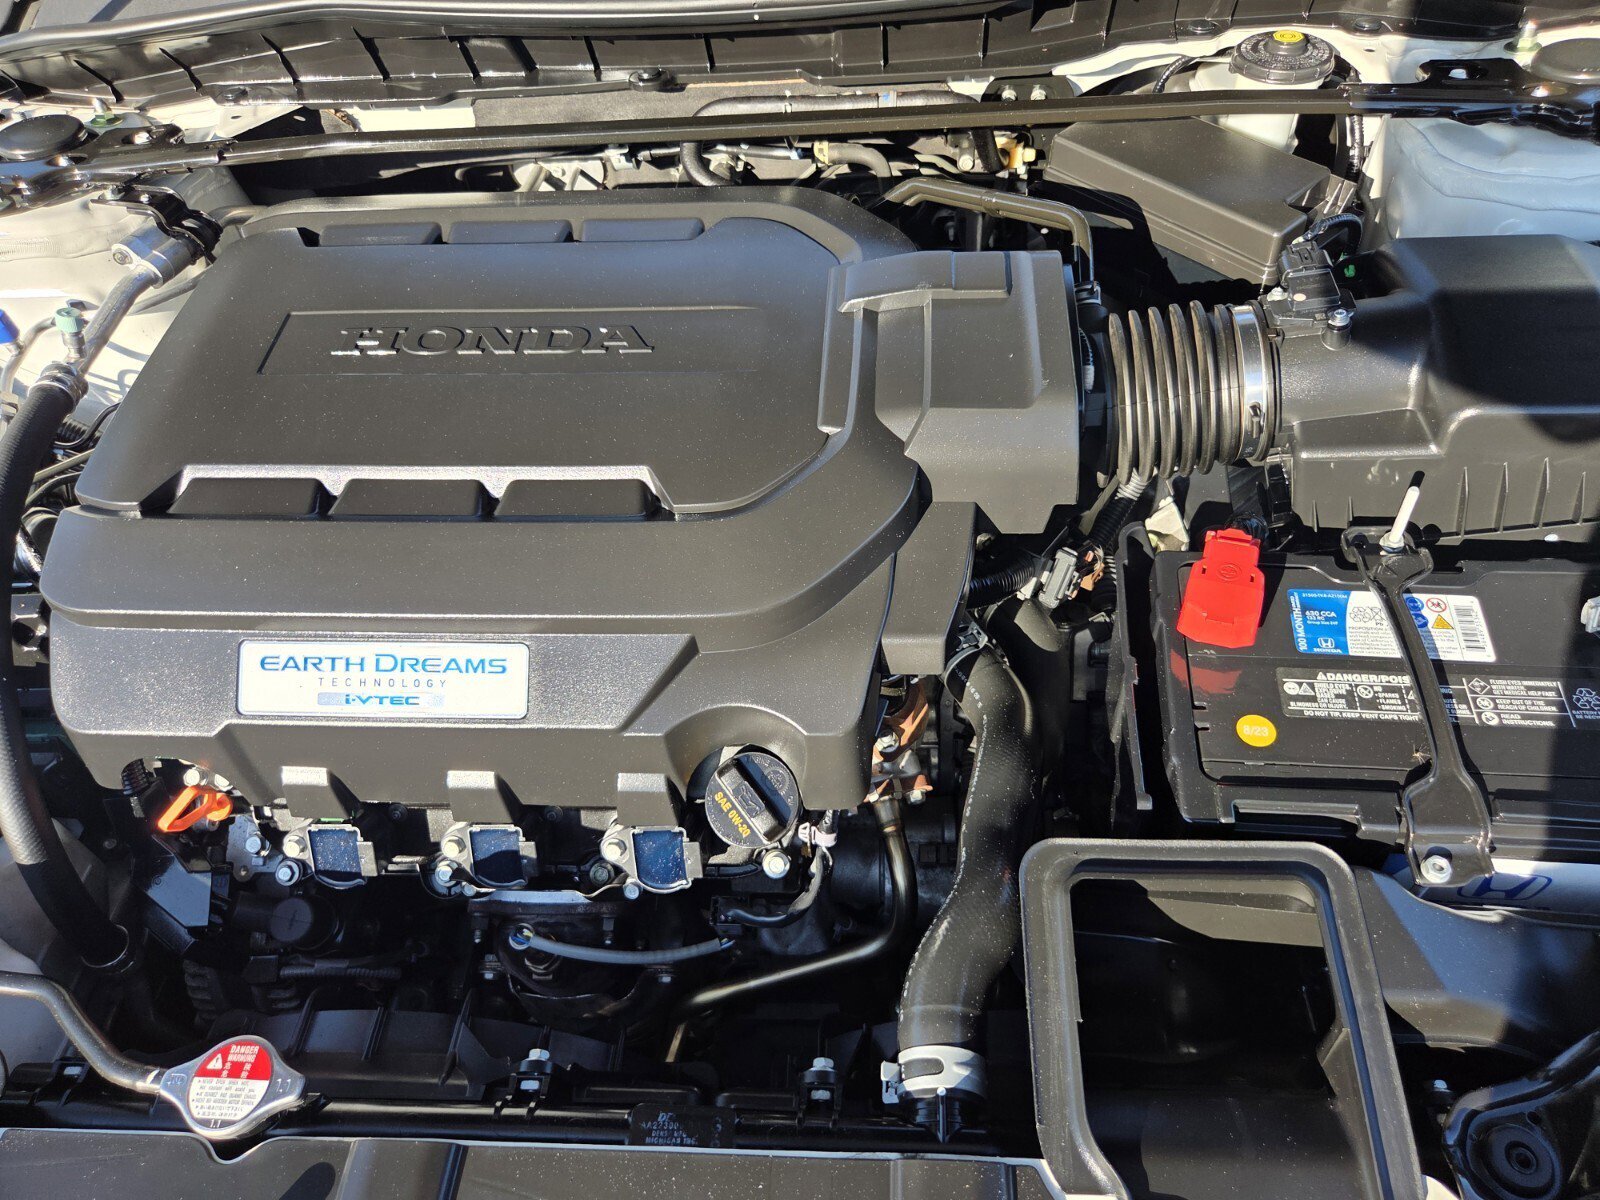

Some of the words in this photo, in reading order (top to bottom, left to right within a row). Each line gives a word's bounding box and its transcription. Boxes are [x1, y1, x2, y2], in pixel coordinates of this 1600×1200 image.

[330, 325, 655, 356] HONDA
[1292, 608, 1306, 638] MONTH
[1298, 638, 1308, 650] 100
[260, 656, 365, 672] EARTH
[375, 653, 508, 674] DREAMS
[318, 677, 447, 688] TECHNOLOGY
[1326, 672, 1411, 684] DANGER/POIS
[345, 694, 420, 706] i-VTEC
[1243, 724, 1268, 736] 8/23
[714, 792, 732, 812] SAE
[728, 810, 751, 838] 0W-20
[230, 1044, 260, 1054] DANGER
[227, 1053, 257, 1063] WARNING
[210, 1119, 222, 1128] 1.1
